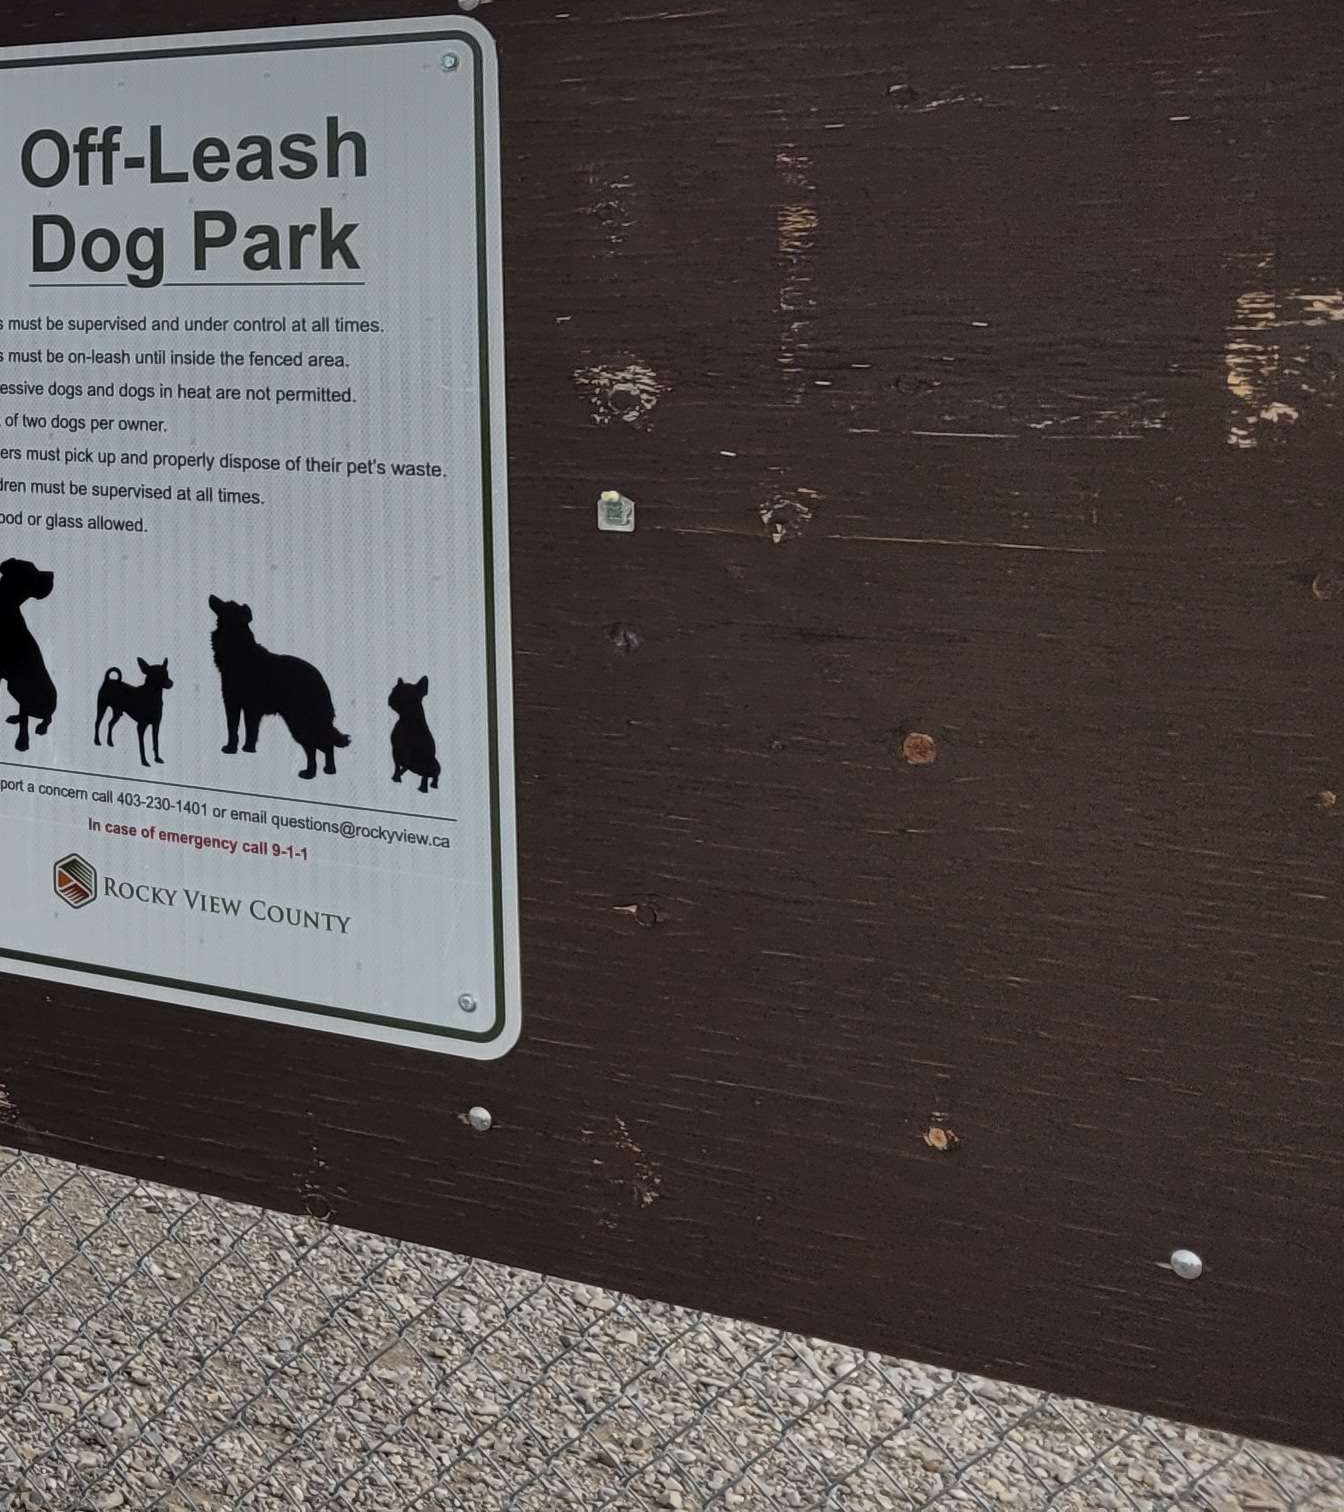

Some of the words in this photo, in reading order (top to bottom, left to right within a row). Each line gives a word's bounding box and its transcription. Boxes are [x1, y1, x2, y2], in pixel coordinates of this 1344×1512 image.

[20, 115, 369, 189] Off-Leash
[31, 213, 166, 288] Dog
[193, 207, 361, 271] Park
[8, 317, 42, 331] must
[46, 316, 64, 331] be
[67, 316, 147, 334] supervised
[151, 317, 180, 331] and
[184, 317, 229, 332] under
[233, 316, 286, 332] control
[291, 317, 307, 332] at
[311, 316, 330, 332] all
[335, 316, 385, 333] times.
[8, 349, 42, 363] must
[46, 348, 64, 363] be
[67, 349, 131, 364] on-leash
[135, 349, 166, 365] until
[171, 350, 215, 365] inside
[220, 350, 245, 366] the
[249, 350, 303, 367] fenced
[308, 355, 350, 368] area.
[48, 381, 83, 400] dogs
[87, 382, 115, 397] and
[118, 383, 155, 401] dogs
[159, 383, 173, 398] in
[177, 383, 212, 400] heat
[215, 388, 241, 401] are
[245, 386, 271, 401] not
[275, 386, 357, 405] permitted.
[4, 412, 19, 427] of
[22, 413, 47, 428] two
[50, 414, 86, 433] dogs
[90, 418, 115, 433] per
[118, 419, 168, 433] owner.
[26, 447, 61, 462] must
[64, 447, 94, 465] pick
[98, 451, 116, 467] up
[120, 451, 148, 465] and
[152, 452, 215, 471] properly
[219, 453, 281, 473] dispose
[285, 455, 302, 471] of
[305, 456, 343, 473] their
[346, 459, 386, 477] pet's
[390, 461, 447, 478] waste.
[30, 480, 65, 495] must
[69, 480, 87, 495] be
[91, 484, 172, 500] supervised
[176, 487, 191, 501] at
[195, 487, 213, 502] all
[218, 487, 265, 505] times.
[27, 514, 43, 526] or
[45, 513, 83, 530] glass
[87, 515, 148, 533] allowed.
[27, 782, 35, 793] a
[38, 784, 88, 800] concern
[92, 790, 113, 804] call
[117, 791, 208, 817] 403-230-1401
[212, 806, 227, 818] or
[230, 808, 267, 825] email
[271, 814, 451, 849] questions@rockyview.ca
[88, 817, 101, 832] In
[105, 823, 137, 837] case
[141, 826, 155, 840] of
[159, 831, 238, 855] emergency
[242, 841, 268, 855] call
[272, 843, 308, 861] 9-1-1
[103, 876, 178, 906] ROCKY
[183, 888, 242, 916] VIEW
[249, 899, 352, 934] COUNTY
